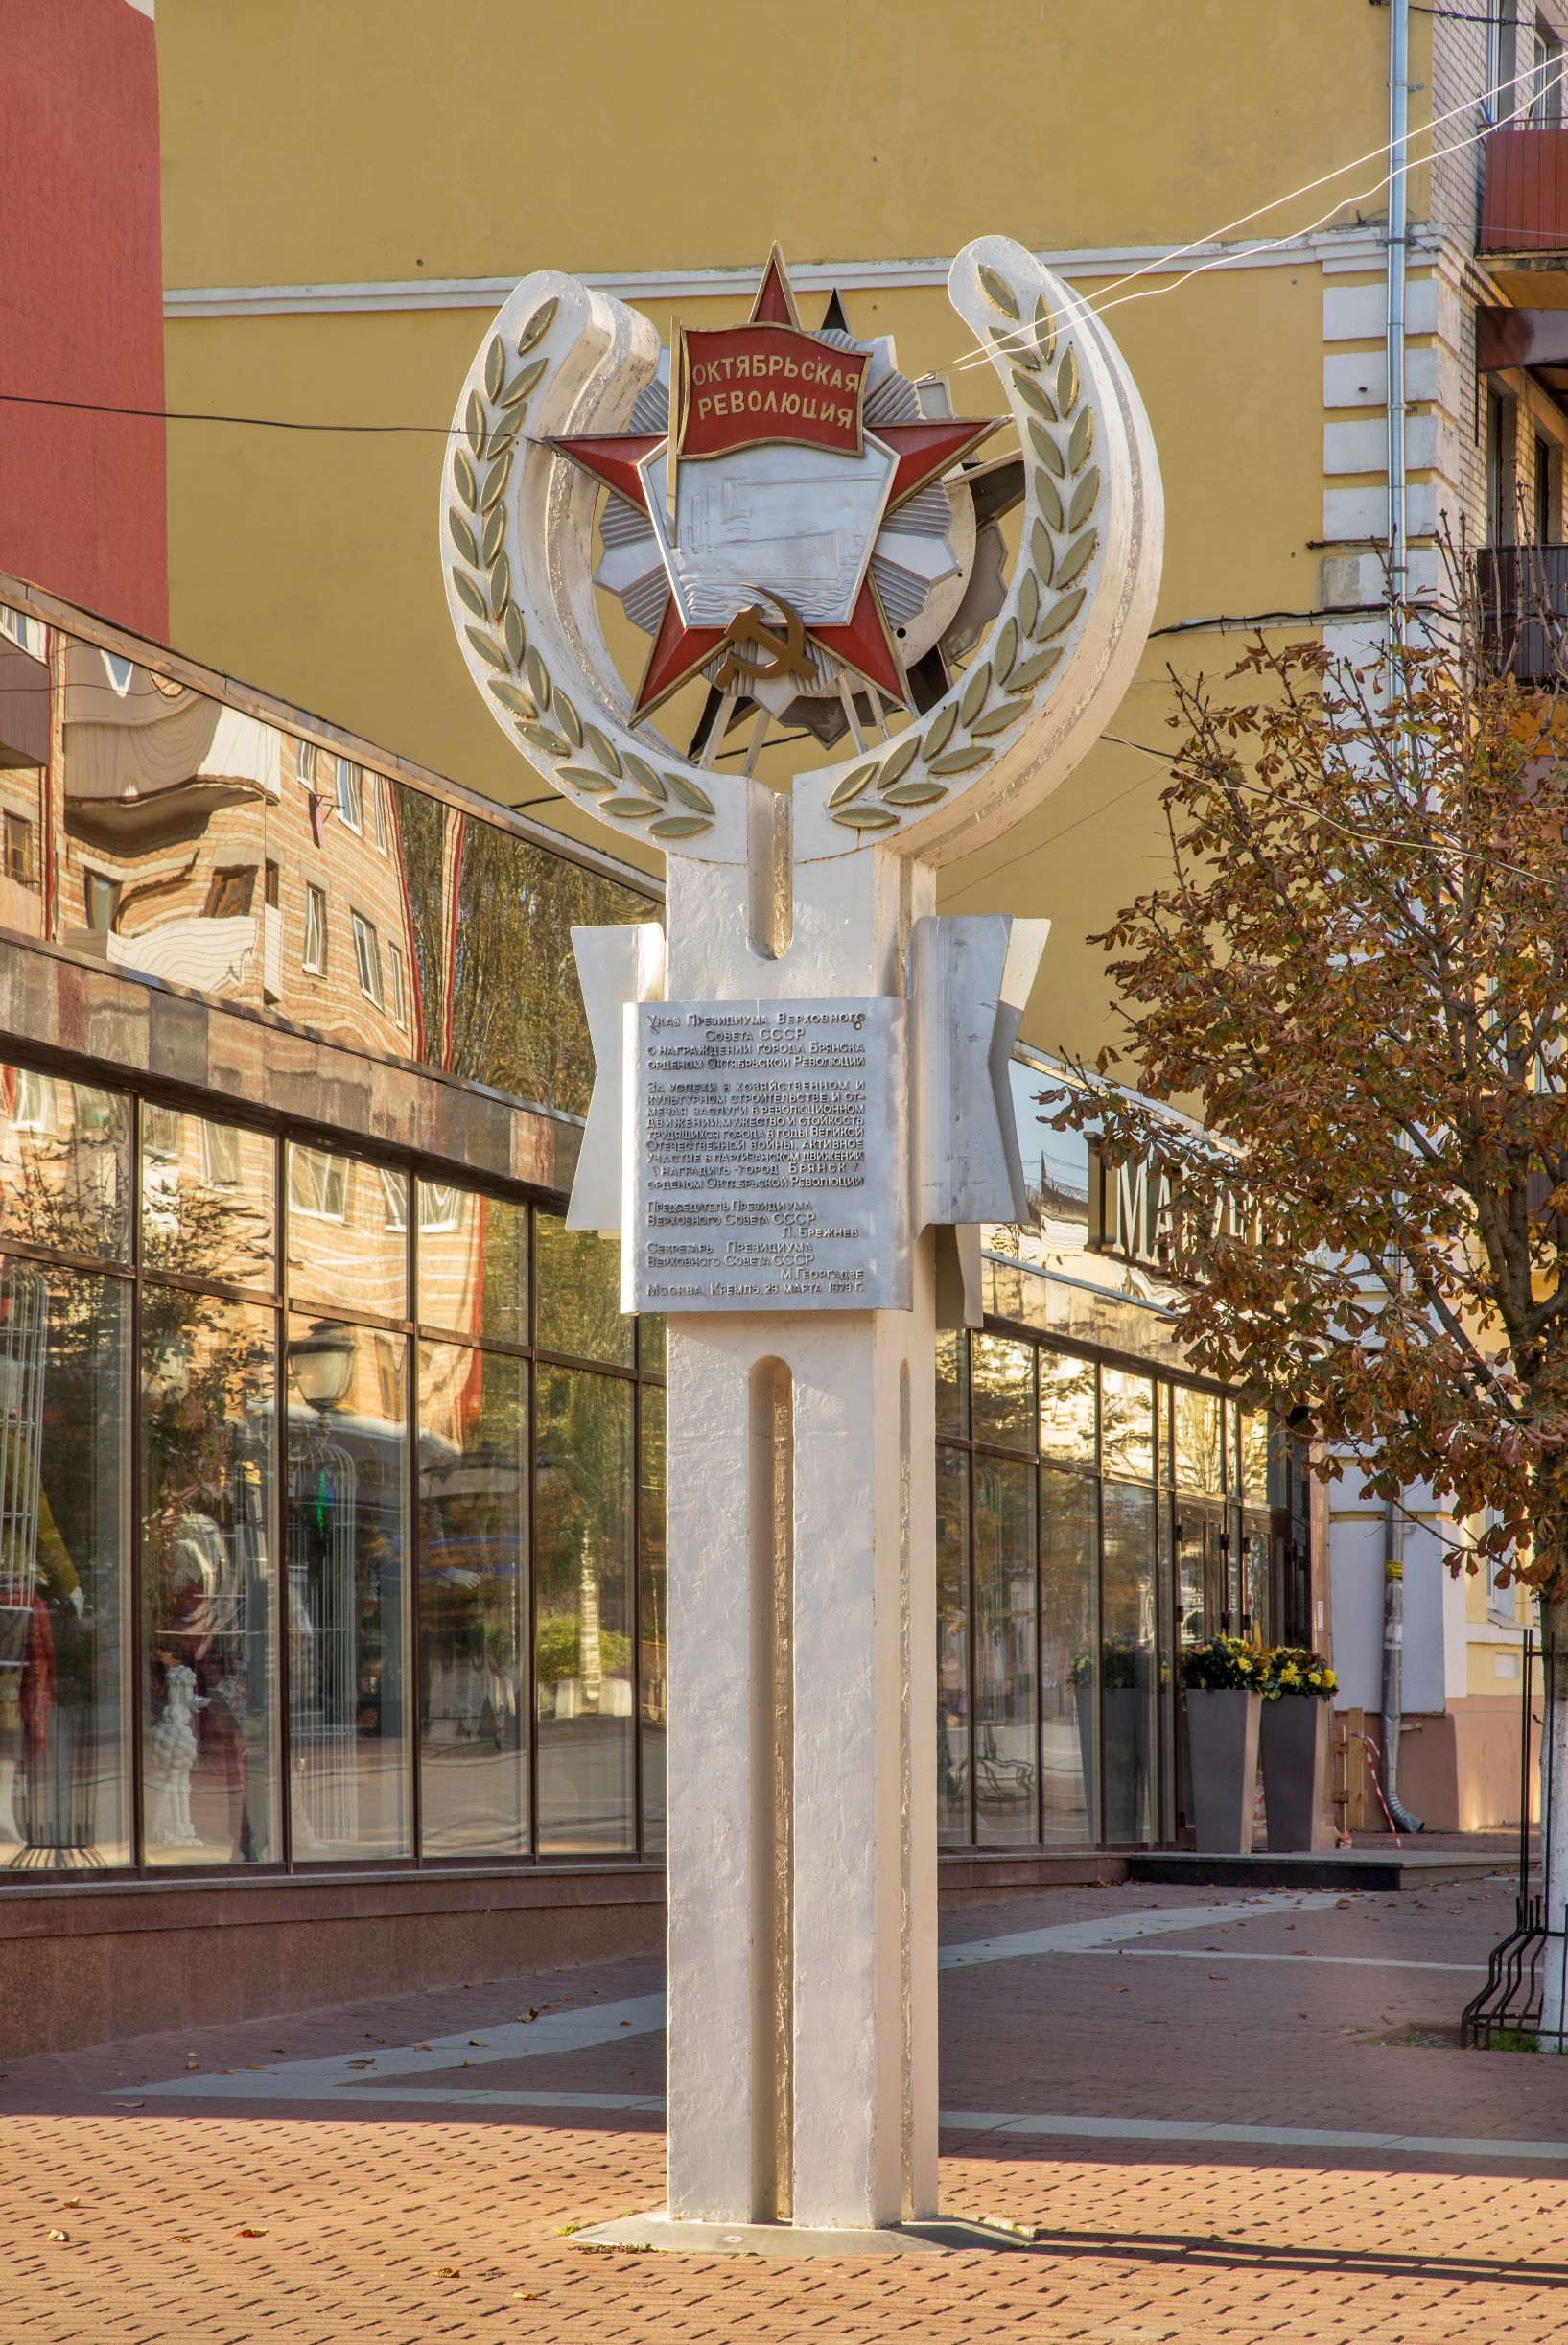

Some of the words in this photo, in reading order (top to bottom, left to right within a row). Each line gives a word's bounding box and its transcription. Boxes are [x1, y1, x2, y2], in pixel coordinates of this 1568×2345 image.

[692, 355, 860, 393] ОКТЯБРЬСКАЯ
[697, 390, 854, 430] РЕВОЛЮЦИЯ
[759, 1027, 806, 1042] СССР
[771, 1212, 816, 1226] СССР
[771, 1254, 815, 1266] СССР
